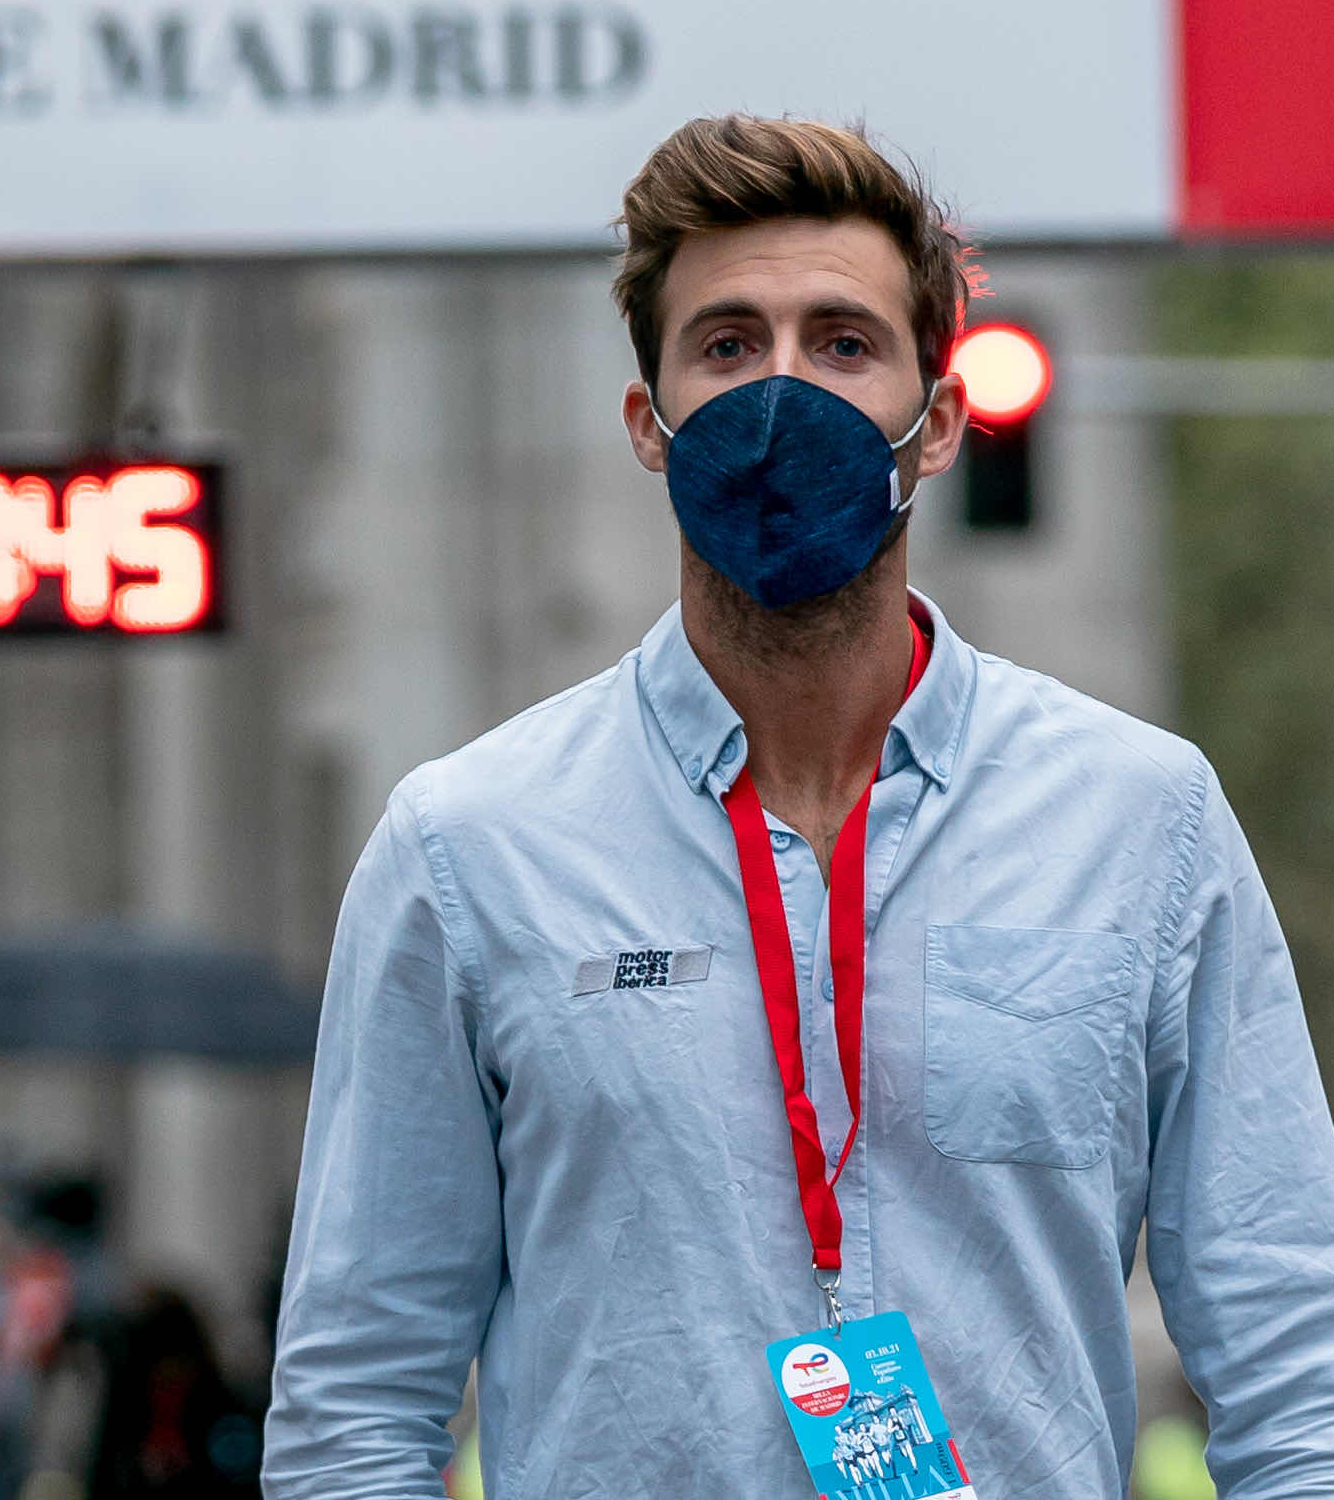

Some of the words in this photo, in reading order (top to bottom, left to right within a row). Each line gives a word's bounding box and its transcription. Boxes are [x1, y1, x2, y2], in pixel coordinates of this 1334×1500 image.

[83, 0, 653, 110] MADRID
[619, 949, 673, 964] motor
[616, 962, 669, 977] press
